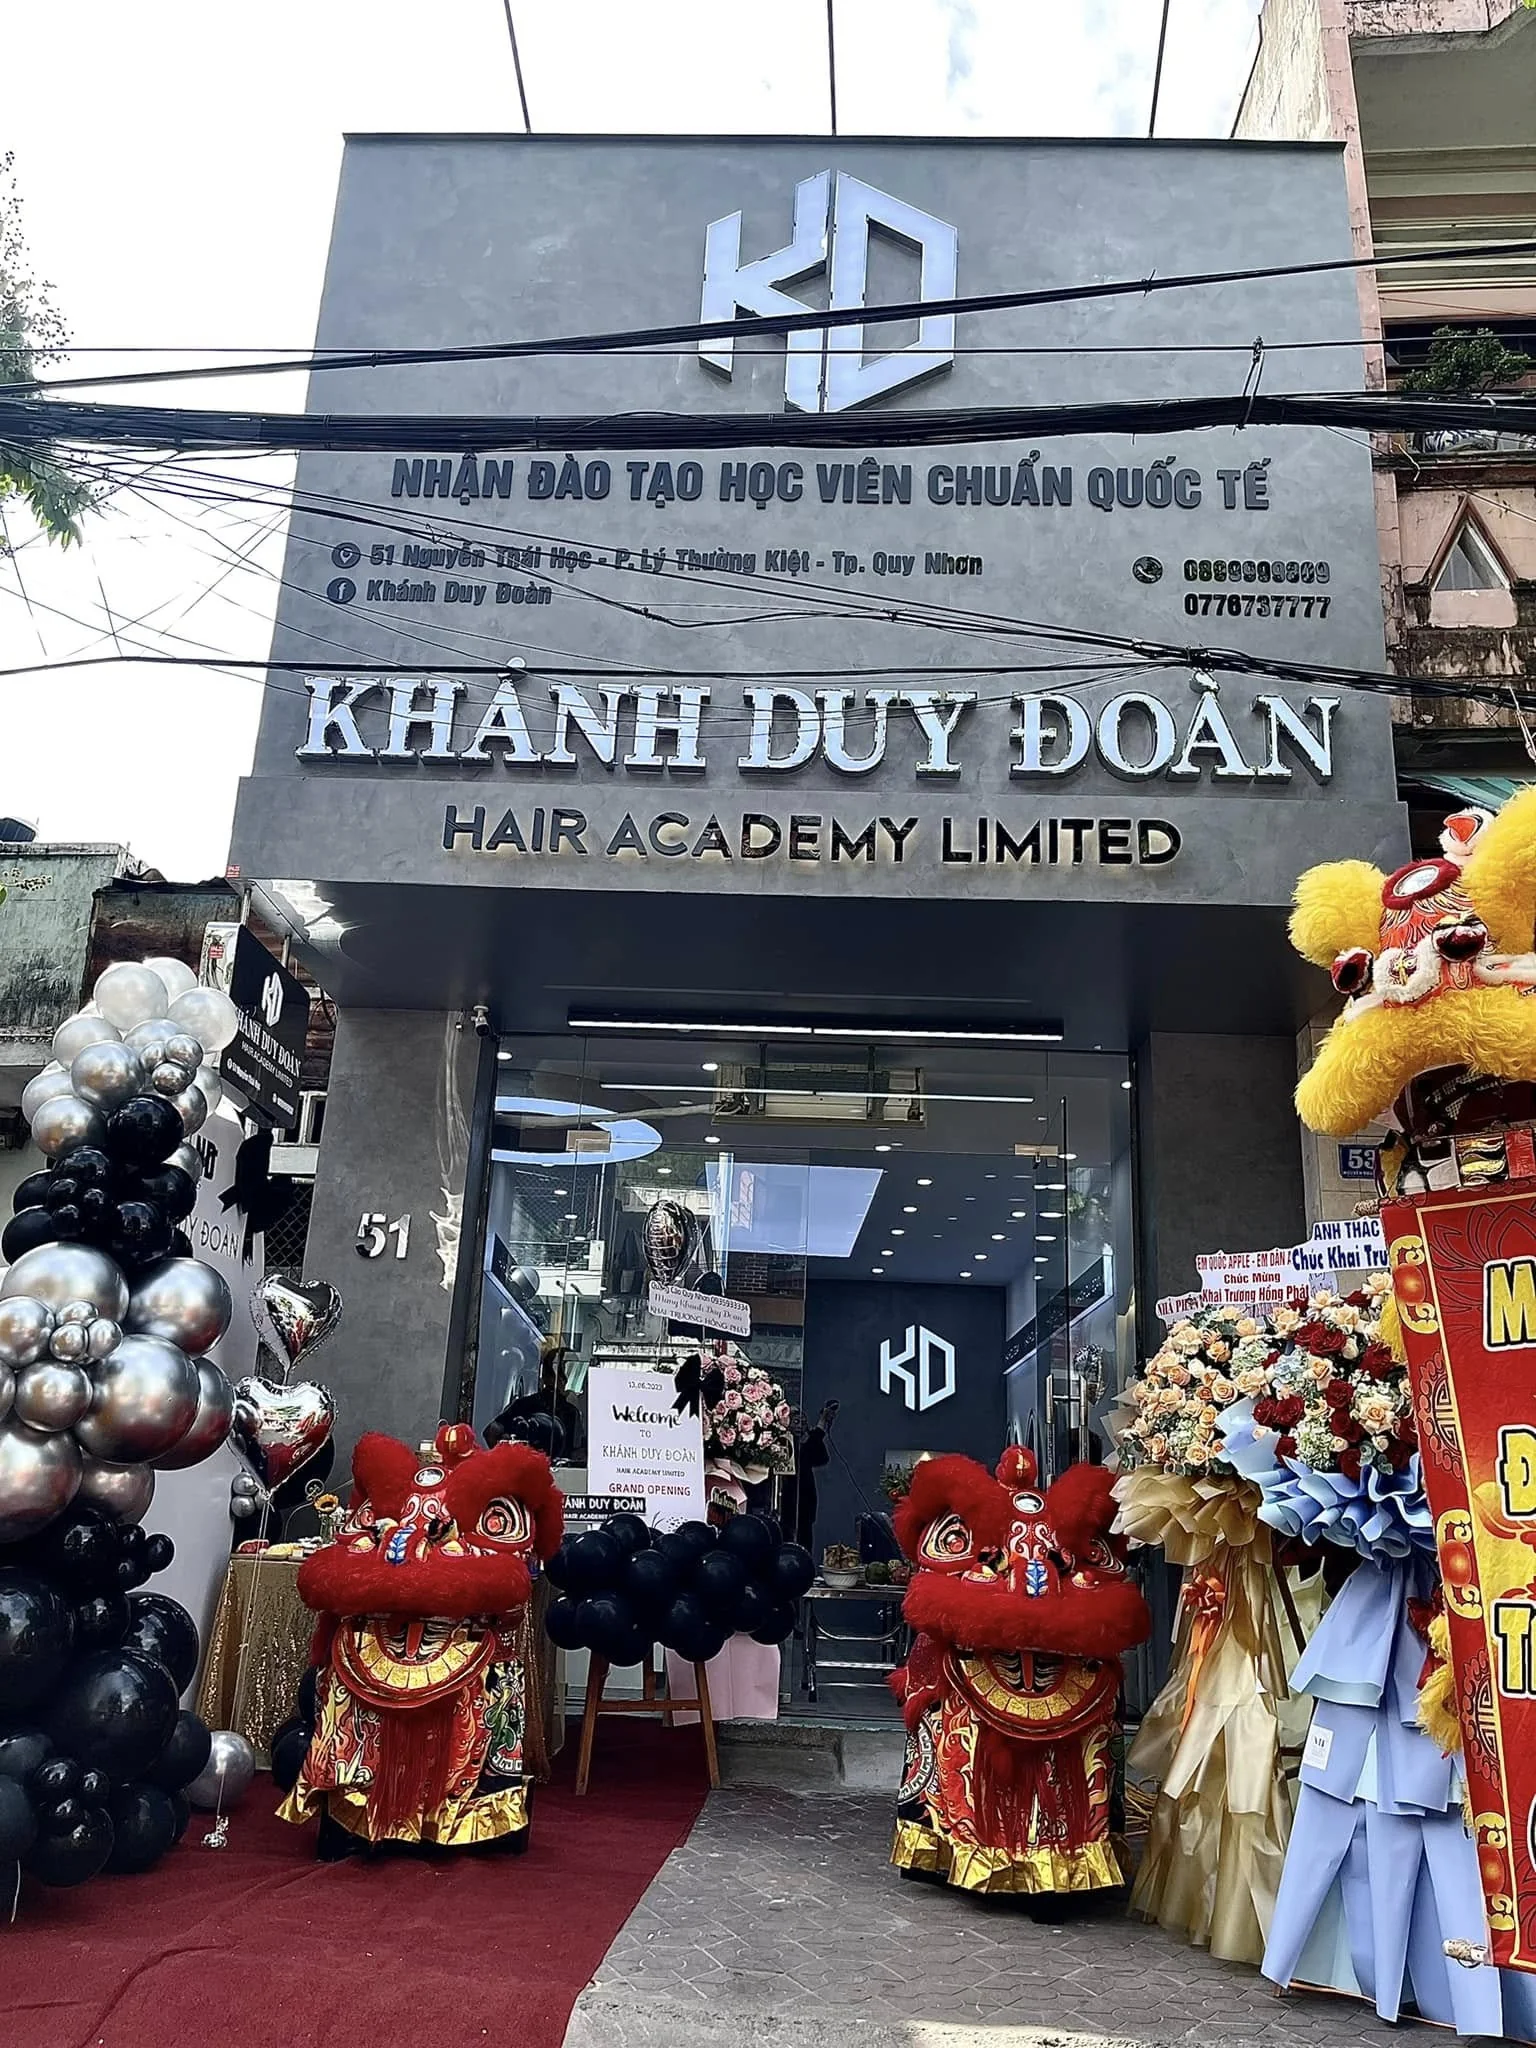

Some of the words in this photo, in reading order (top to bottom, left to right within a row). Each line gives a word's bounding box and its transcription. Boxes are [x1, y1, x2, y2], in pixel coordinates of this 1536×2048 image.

[390, 452, 514, 505] NHẬN
[527, 453, 610, 500] ĐÀO
[626, 460, 702, 507] TẠO
[720, 461, 803, 509] HỌC
[817, 457, 912, 504] VIÊN
[927, 449, 1073, 506] CHUẨN
[1088, 456, 1202, 511] QUỐC
[1217, 458, 1271, 509] TẾ
[369, 544, 395, 565] 51
[550, 547, 592, 573] Học
[676, 547, 756, 573] Thường
[765, 549, 810, 577] Kiệt
[832, 551, 866, 576] Tp.
[873, 552, 915, 576] Quy
[924, 552, 983, 575] Nhơn
[366, 578, 436, 602] Khánh
[444, 581, 487, 605] Duy
[495, 581, 552, 605] Đoàn
[296, 657, 711, 773] KHÁNH
[737, 686, 978, 779] DUY
[1008, 670, 1342, 785] ĐOÀN
[442, 805, 588, 856] HAIR
[606, 811, 919, 865] ACADEMY
[941, 816, 1184, 867] LIMITED
[261, 1027, 279, 1060] DUY
[278, 1049, 301, 1079] ĐOÀN
[200, 1219, 239, 1259] ĐOÀN
[355, 1213, 411, 1260] 51
[1314, 1222, 1341, 1241] ANH
[1197, 1256, 1208, 1271] EM
[1228, 1254, 1250, 1270] APPLE
[1257, 1253, 1268, 1268] EM
[1292, 1248, 1324, 1271] Chúc
[1327, 1245, 1360, 1268] Khai
[1224, 1273, 1249, 1284] Chúc
[1252, 1271, 1281, 1284] Mừng
[1202, 1288, 1222, 1304] Khai
[1225, 1287, 1256, 1304] Trương
[612, 1404, 681, 1429] Welcome
[640, 1429, 651, 1438] TO
[602, 1444, 638, 1458] KHÁNH
[642, 1447, 662, 1461] DUY
[665, 1448, 696, 1463] ĐOÀN
[609, 1482, 644, 1494] GRAND
[648, 1484, 691, 1496] OPENING
[589, 1498, 610, 1510] DUY
[614, 1497, 644, 1511] ĐOÀN
